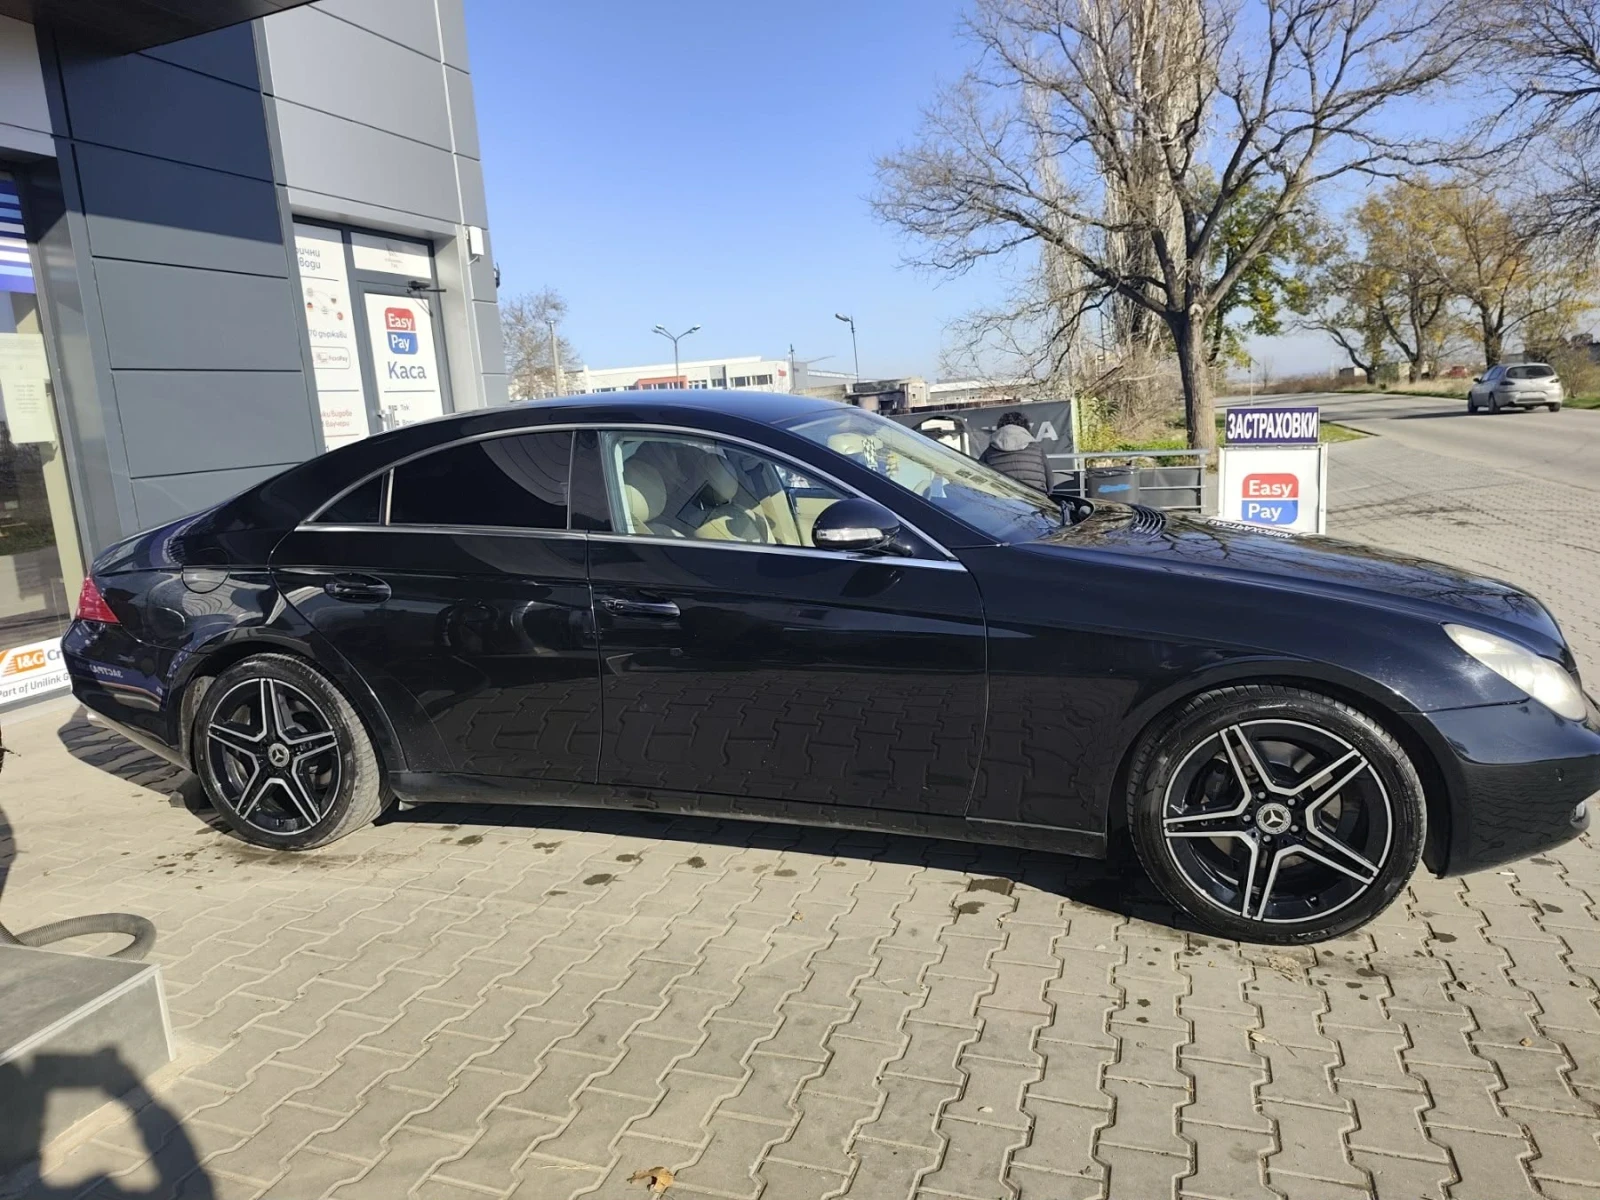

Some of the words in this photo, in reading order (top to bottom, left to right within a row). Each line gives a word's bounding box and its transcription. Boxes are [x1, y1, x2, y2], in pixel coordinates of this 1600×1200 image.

[387, 312, 414, 330] Easy
[390, 333, 411, 351] Pay
[388, 360, 427, 380] Каса
[1227, 411, 1318, 440] ЗАСТРАХОВКИ
[1248, 479, 1294, 498] Easy
[1248, 502, 1283, 521] Pay
[16, 651, 45, 670] I&G
[18, 682, 29, 695] of
[30, 674, 63, 690] Unilink
